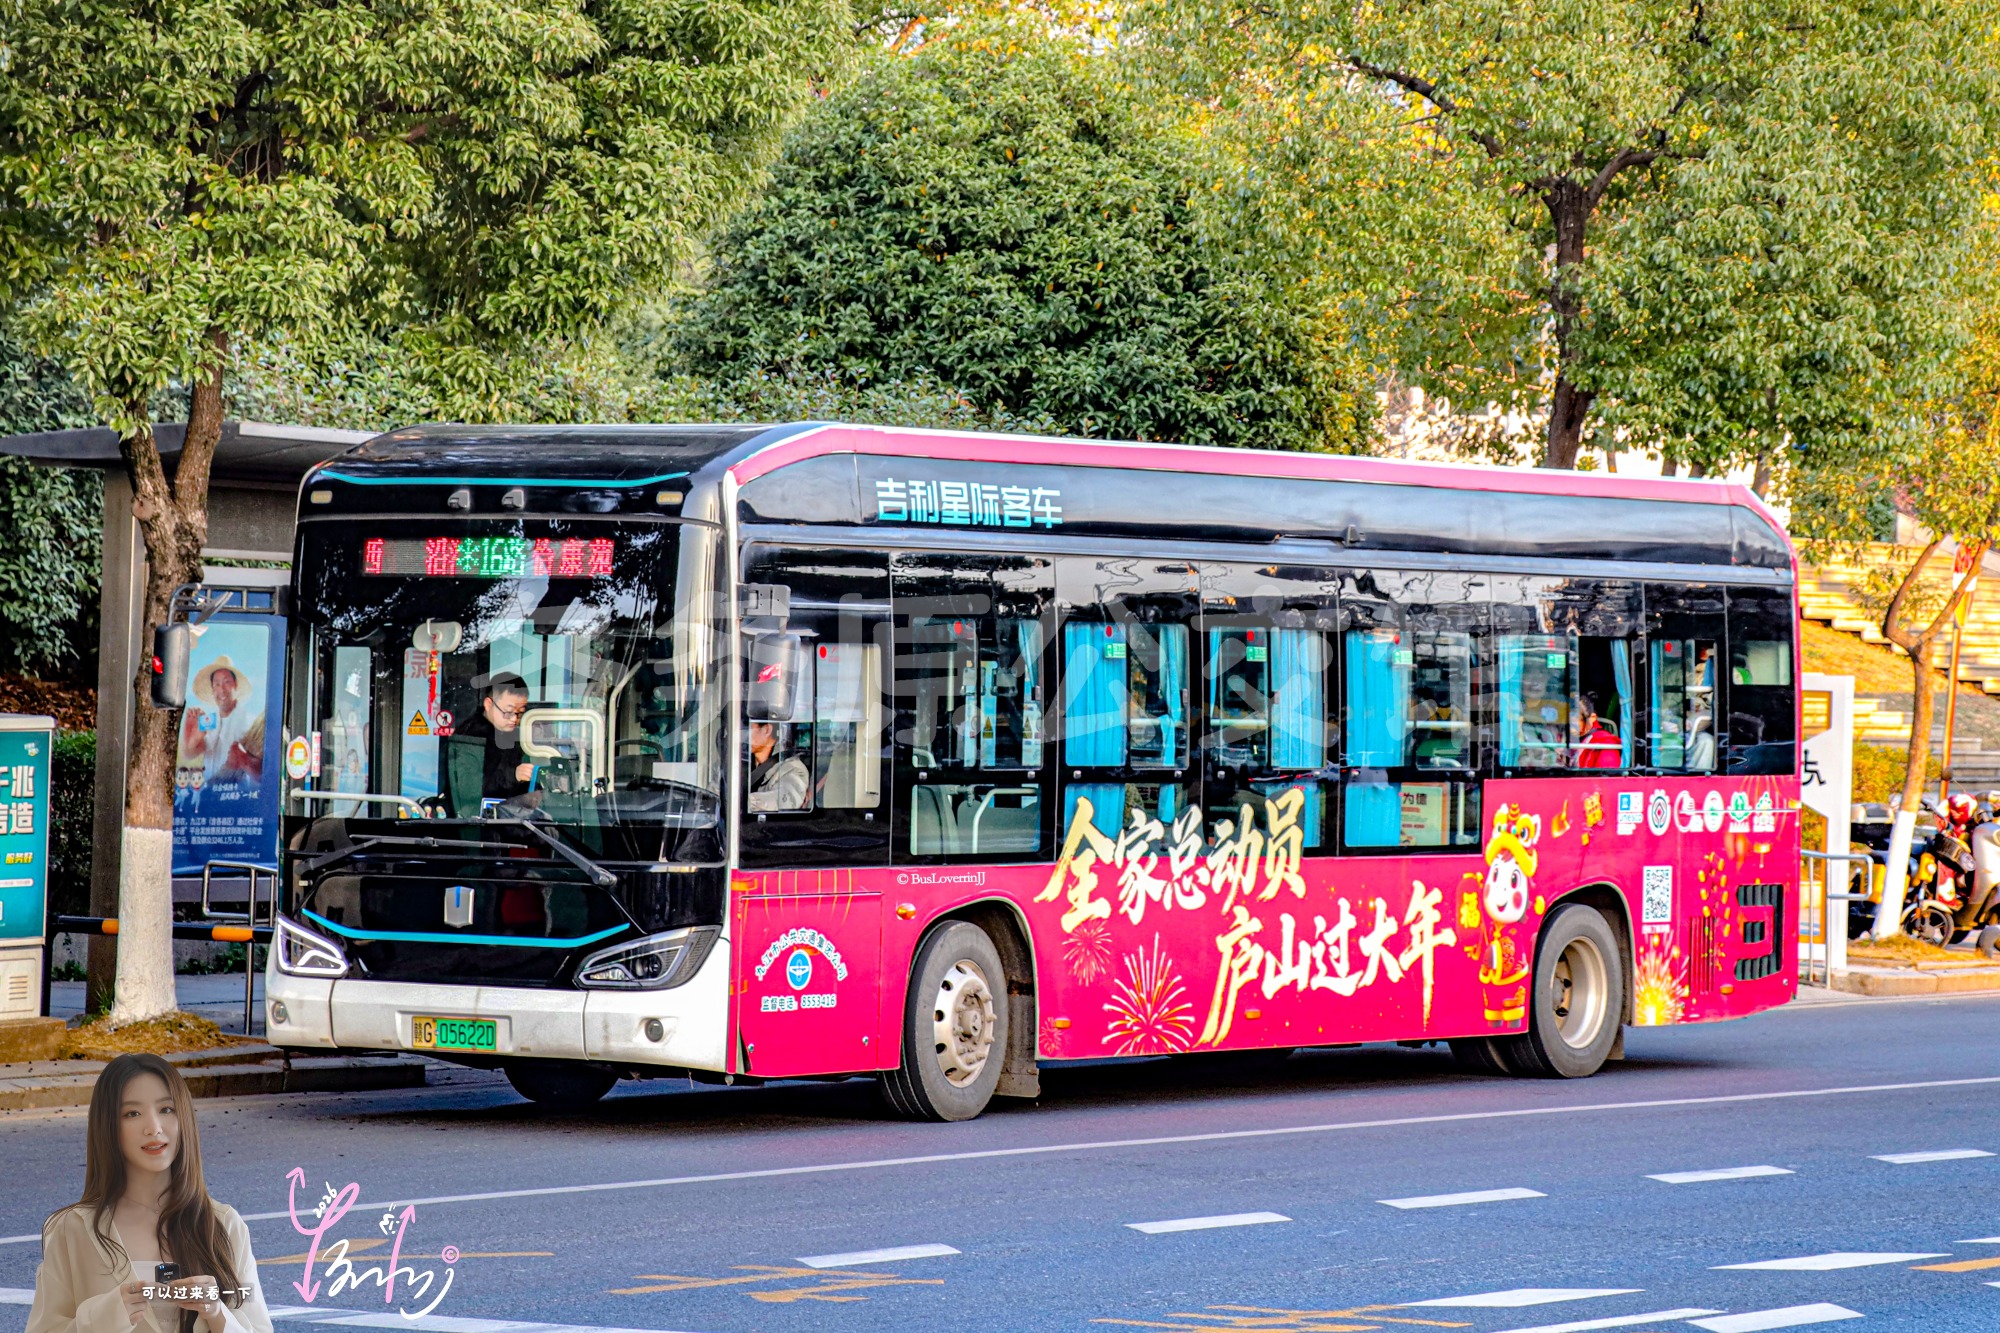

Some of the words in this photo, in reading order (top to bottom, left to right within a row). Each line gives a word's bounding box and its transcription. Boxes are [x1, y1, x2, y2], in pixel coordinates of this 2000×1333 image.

[875, 477, 1063, 529] 吉利星际客车
[1034, 788, 1307, 934] 全家总动员
[1460, 892, 1481, 928] 福
[1194, 879, 1458, 1048] 庐山过大年
